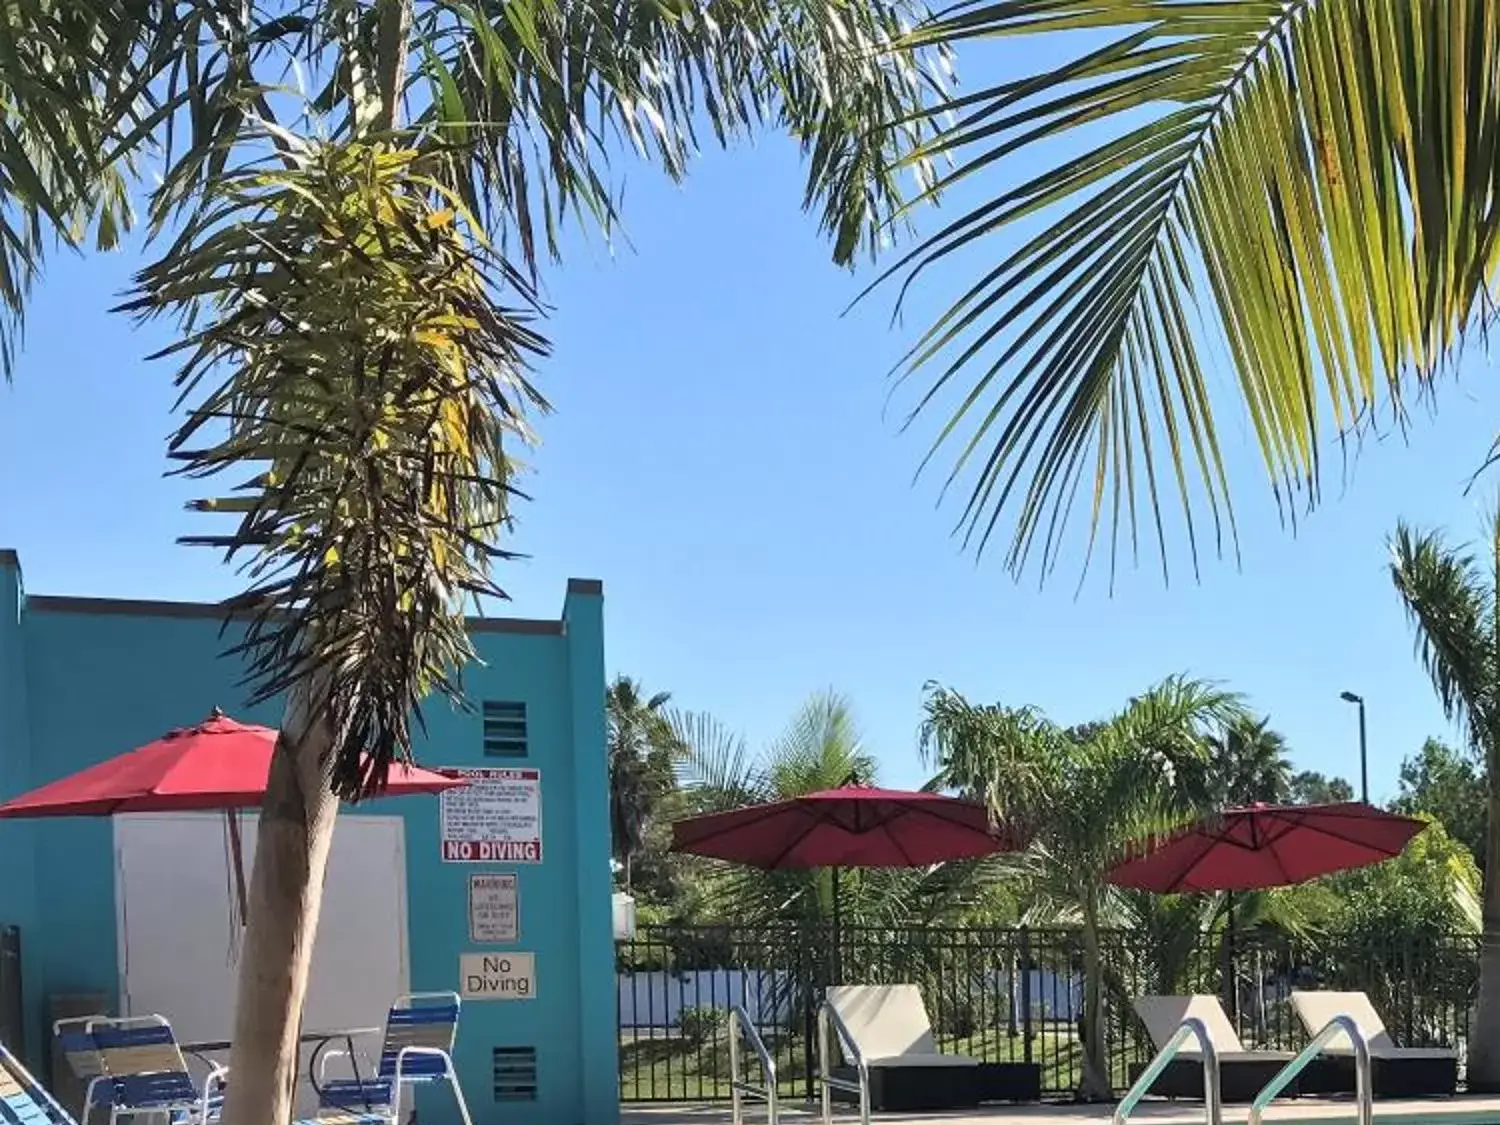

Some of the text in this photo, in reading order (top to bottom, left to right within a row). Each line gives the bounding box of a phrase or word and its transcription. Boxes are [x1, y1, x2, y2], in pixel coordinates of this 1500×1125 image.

[447, 841, 536, 860] NO DIVING
[483, 957, 511, 973] No
[467, 975, 529, 995] Diving
